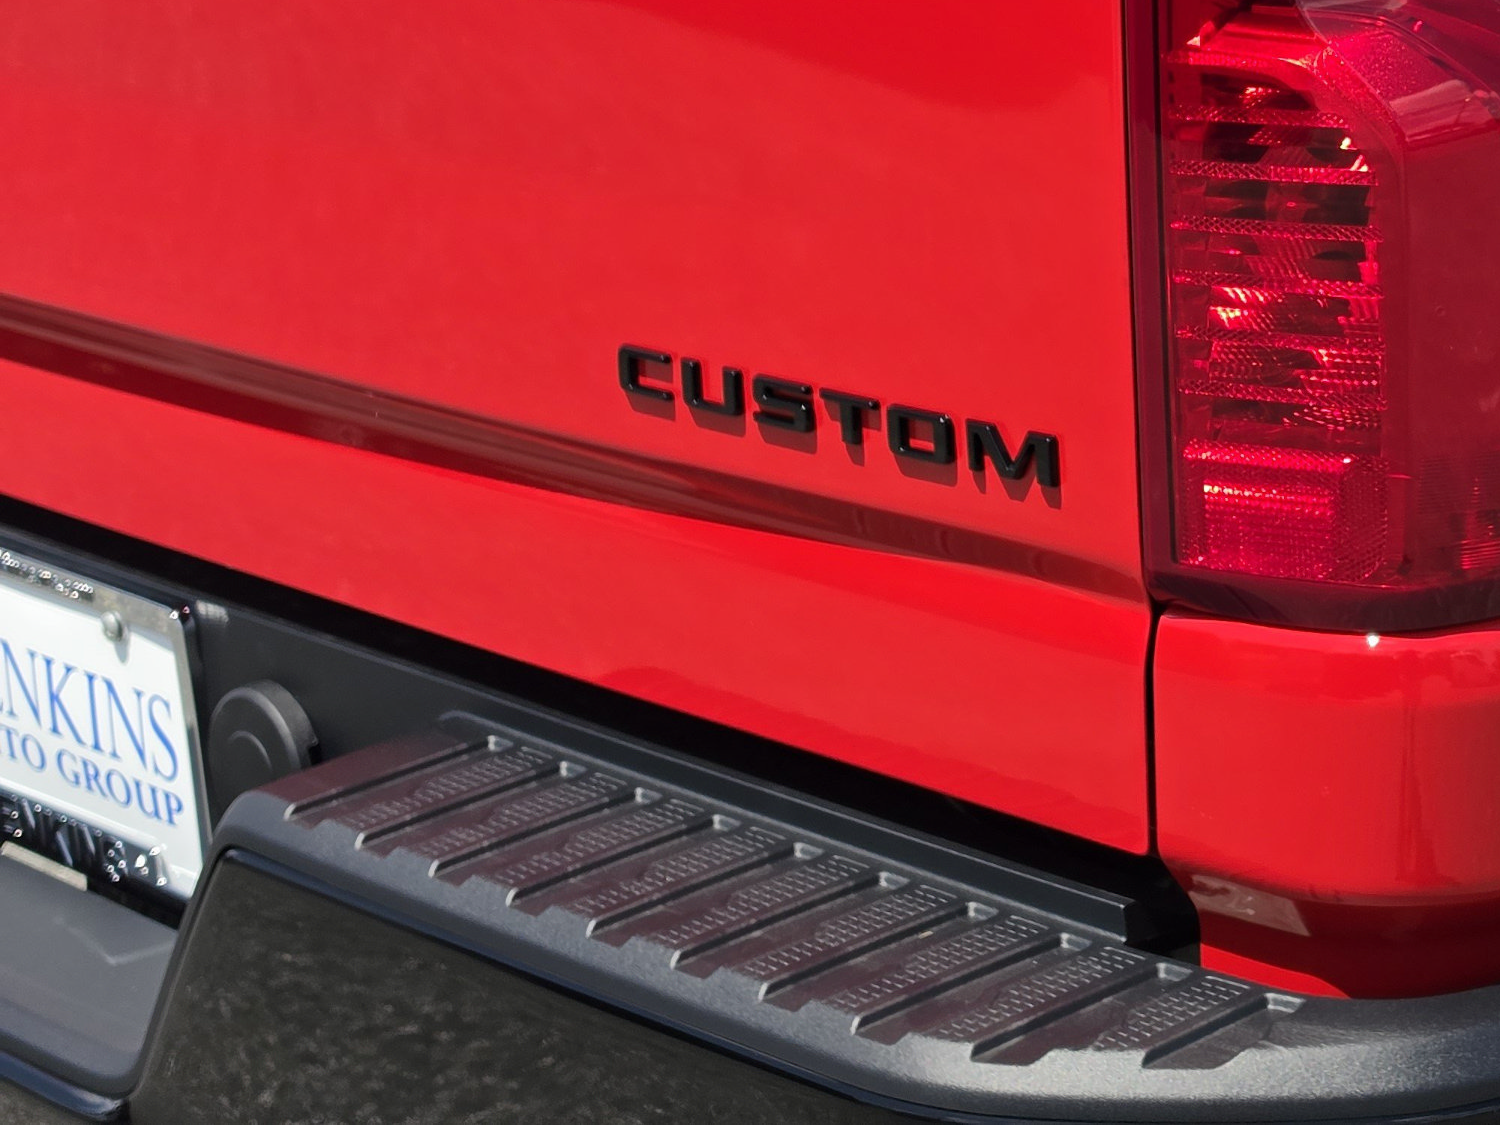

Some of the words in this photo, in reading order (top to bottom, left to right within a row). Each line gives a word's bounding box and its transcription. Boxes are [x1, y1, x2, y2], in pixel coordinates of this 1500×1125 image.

[617, 342, 1060, 488] CUSTOM
[0, 636, 178, 782] NKINS
[55, 748, 184, 826] GROUP
